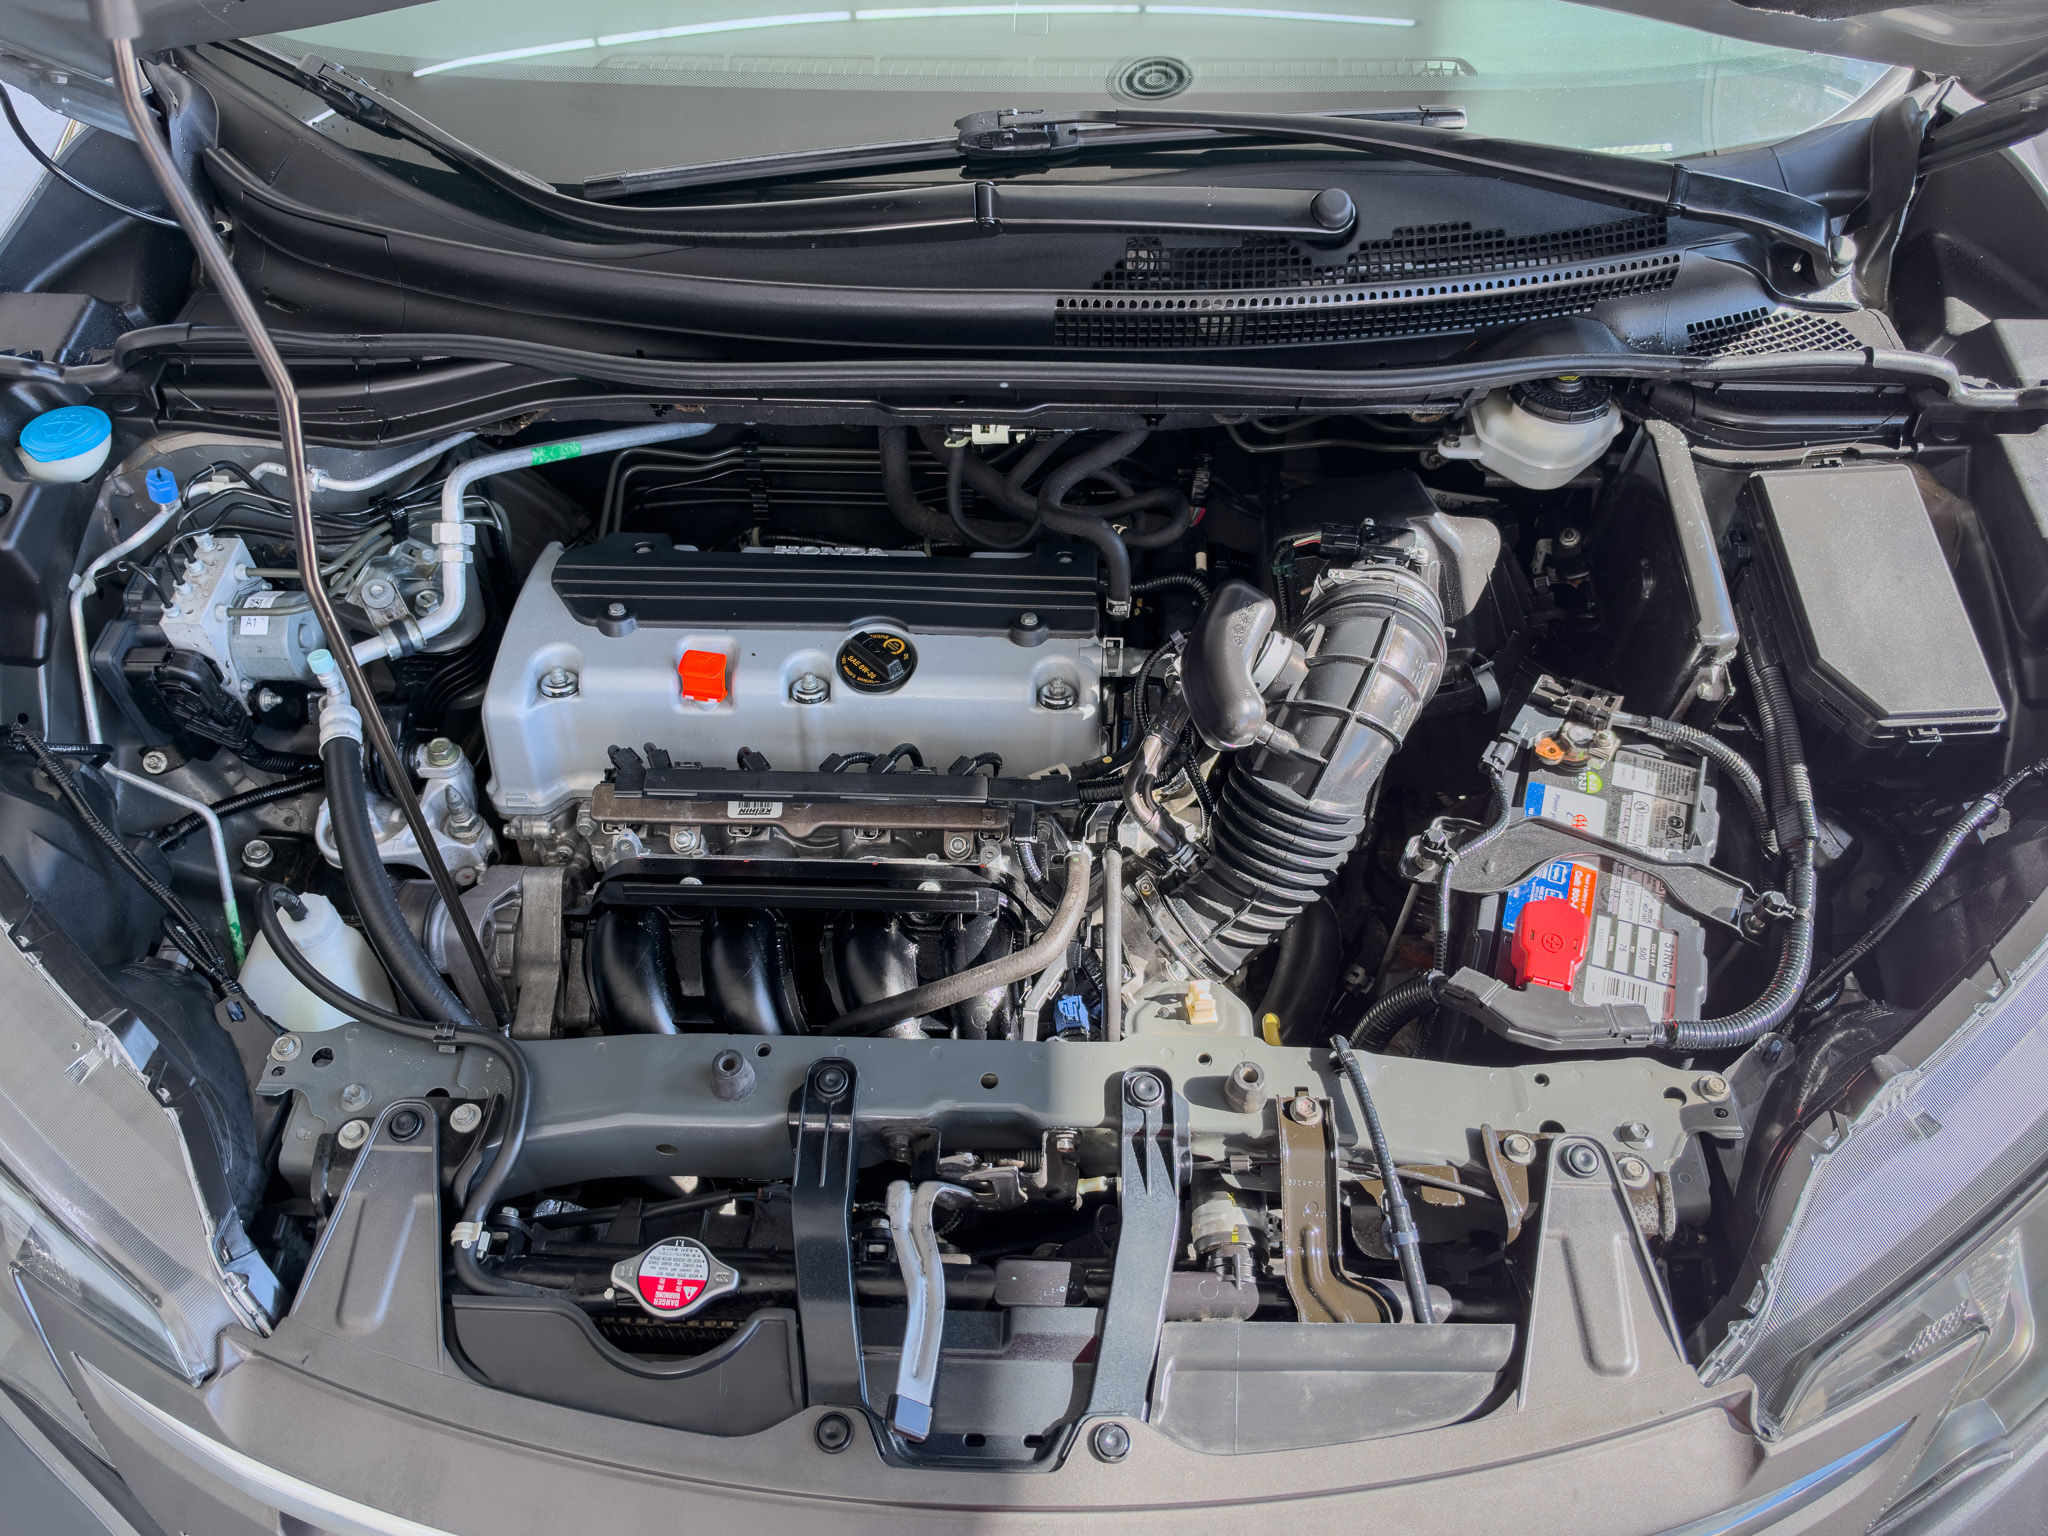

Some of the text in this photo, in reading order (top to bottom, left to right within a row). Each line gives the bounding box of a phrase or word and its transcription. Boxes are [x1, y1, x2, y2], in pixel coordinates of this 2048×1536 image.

[773, 545, 889, 557] HONDA
[245, 617, 257, 627] A1
[847, 655, 877, 679] SAE 0W-20
[1552, 794, 1561, 812] Power
[737, 808, 772, 816] KEIHIN
[1573, 870, 1583, 886] Call:
[1581, 888, 1589, 902] battery
[1619, 944, 1627, 952] 75
[1662, 942, 1674, 980] 51RN-C
[653, 1298, 680, 1307] DANGER
